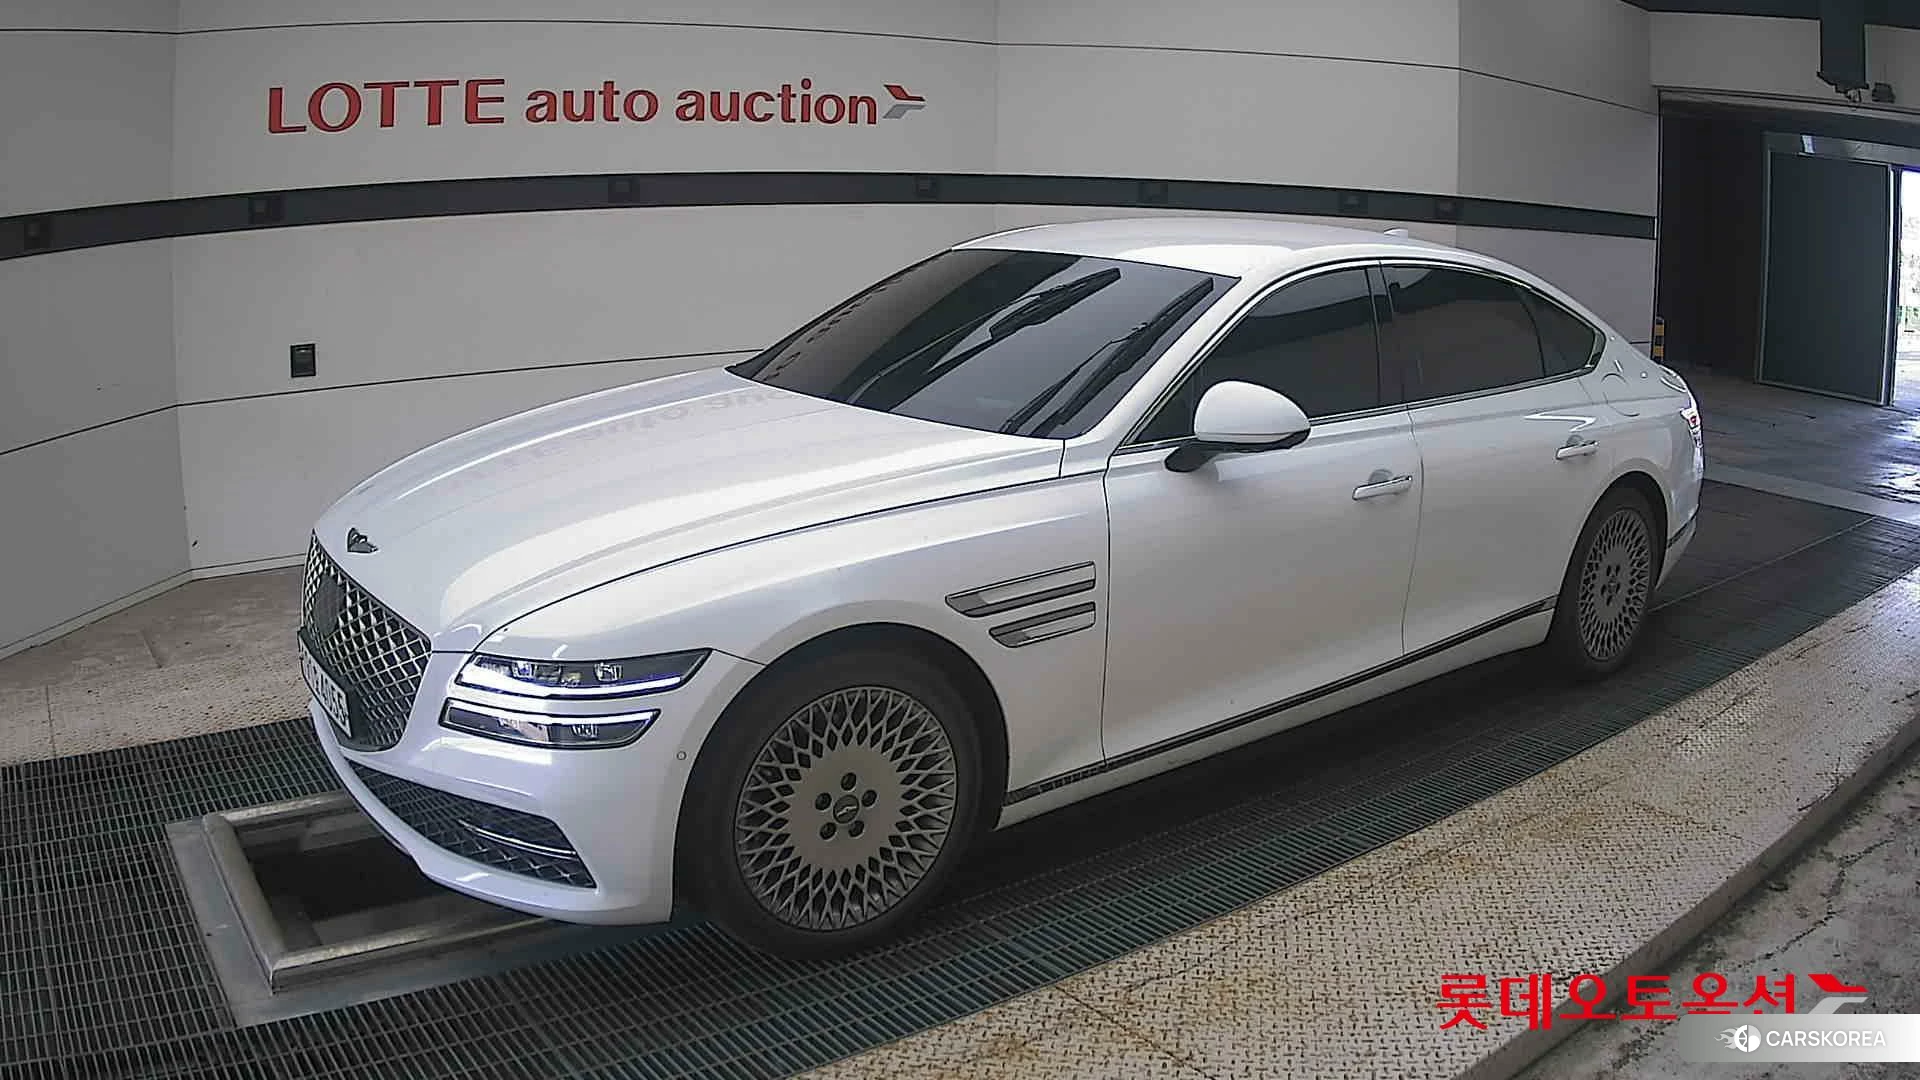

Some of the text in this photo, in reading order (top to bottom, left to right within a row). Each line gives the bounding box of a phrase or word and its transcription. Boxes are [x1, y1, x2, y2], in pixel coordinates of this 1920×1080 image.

[268, 78, 877, 134] LOTTE auto auction
